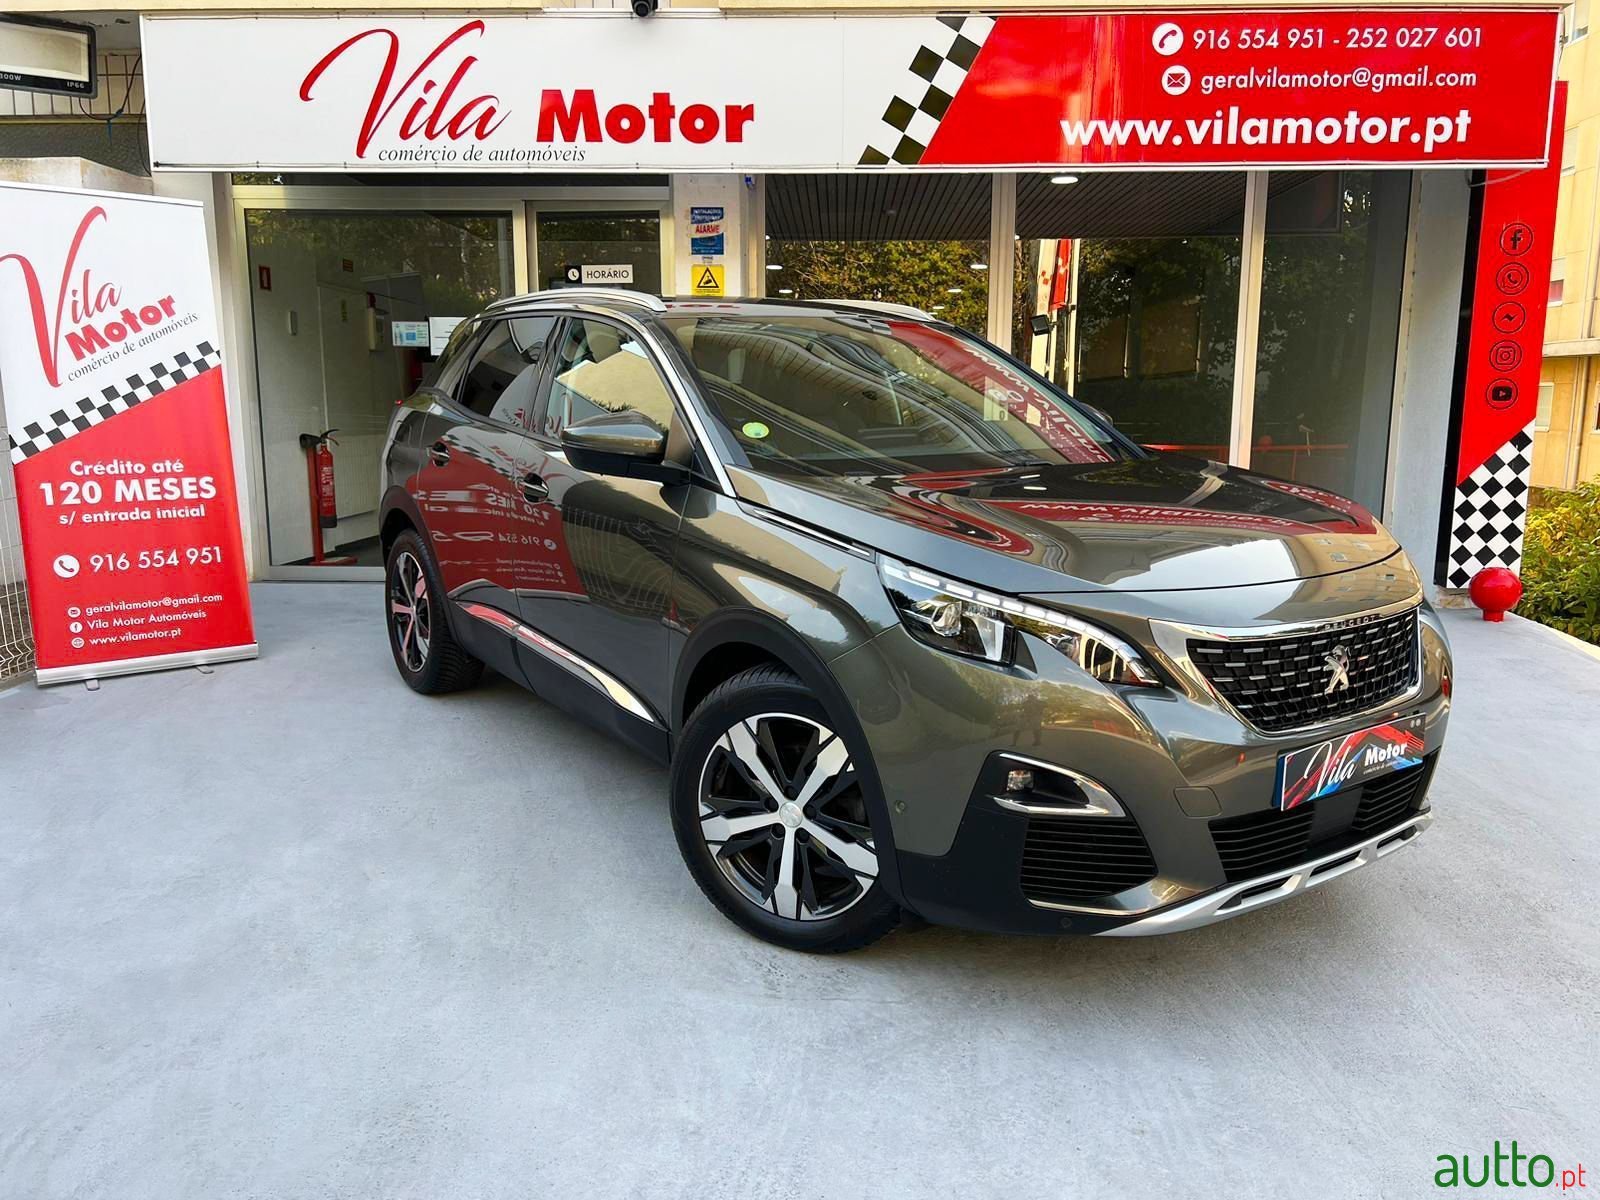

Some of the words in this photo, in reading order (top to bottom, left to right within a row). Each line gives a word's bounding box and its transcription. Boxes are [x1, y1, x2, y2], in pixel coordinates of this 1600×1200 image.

[1193, 29, 1230, 50] 916
[1237, 28, 1279, 49] 554
[1287, 28, 1323, 49] 951
[1346, 27, 1388, 48] 252
[1395, 27, 1439, 48] 027
[1444, 27, 1482, 48] 601
[300, 19, 511, 159] Vila
[536, 88, 756, 145] Motor
[1200, 65, 1477, 95] geralvilamotor@gmail.com
[1060, 106, 1472, 153] www.vilamotor.pt
[378, 144, 457, 161] comércio
[462, 144, 484, 161] de
[488, 144, 586, 162] automóveis
[695, 223, 720, 234] ALARME
[586, 268, 630, 280] HORÁRIO
[0, 206, 122, 388] Vila
[64, 294, 176, 361] Motor
[67, 350, 120, 382] comércio
[122, 342, 137, 356] de
[138, 311, 198, 348] automóveis
[69, 458, 146, 477] Crédito
[151, 458, 185, 474] até
[39, 480, 103, 506] 120
[114, 475, 217, 503] MESES
[59, 510, 76, 526] s/
[82, 507, 152, 524] entrada
[156, 503, 206, 519] inicial
[89, 552, 130, 573] 916
[138, 549, 180, 569] 554
[186, 546, 222, 565] 951
[85, 593, 223, 617] geralvilamotor@gmail.com
[87, 619, 109, 630] Vila
[113, 616, 145, 628] Motor
[148, 609, 207, 624] Automóveis
[1324, 615, 1375, 631] PEUGEOT
[89, 627, 182, 646] www.vilamotor.pt
[1303, 734, 1358, 797] Vila
[1364, 743, 1408, 767] Motor
